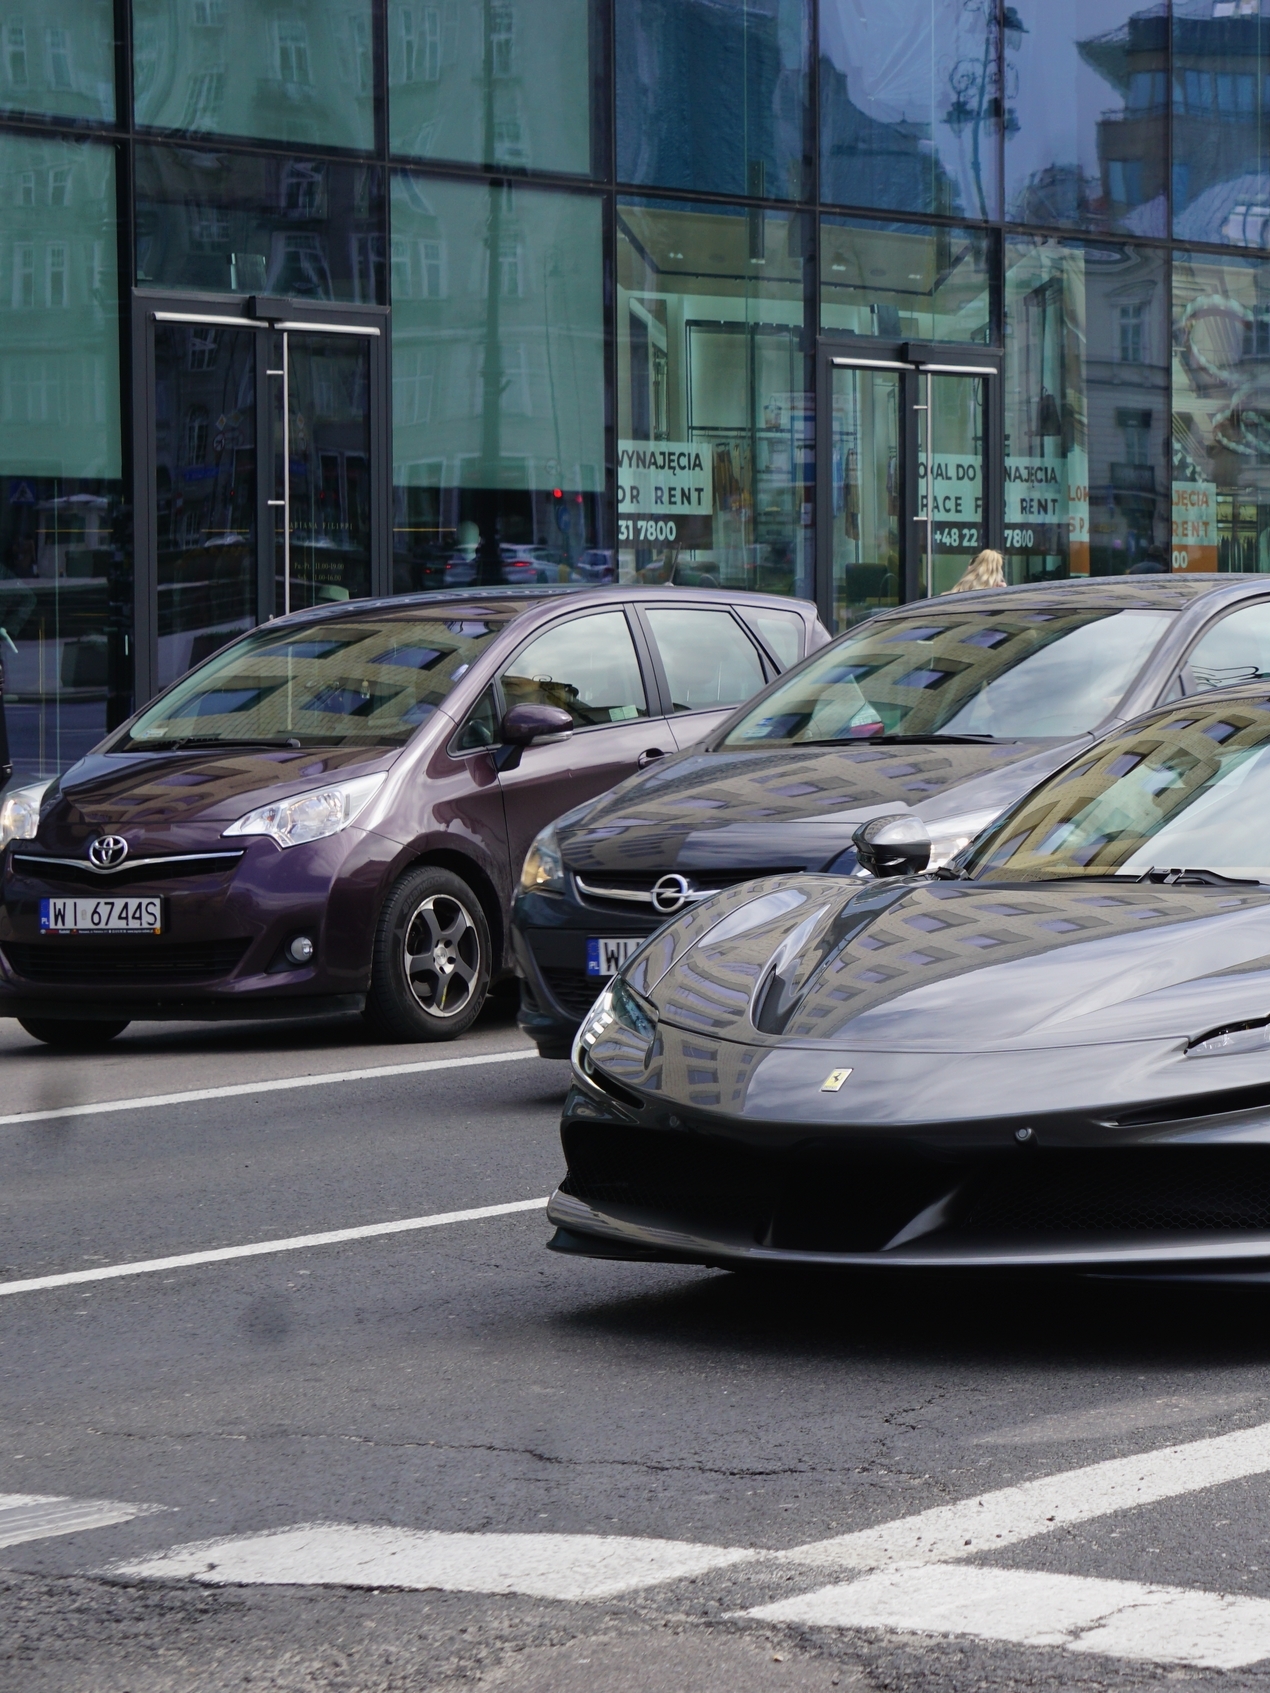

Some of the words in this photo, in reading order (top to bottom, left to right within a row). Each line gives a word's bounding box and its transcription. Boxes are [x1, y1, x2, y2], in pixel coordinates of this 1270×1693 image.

[956, 463, 976, 481] DO
[655, 486, 704, 506] RENT
[1020, 498, 1058, 515] RENT
[637, 521, 676, 541] 7800
[935, 529, 959, 547] +48
[962, 530, 978, 547] 22
[1004, 530, 1034, 547] 7800
[53, 901, 78, 927] WI
[90, 901, 158, 927] 6744S
